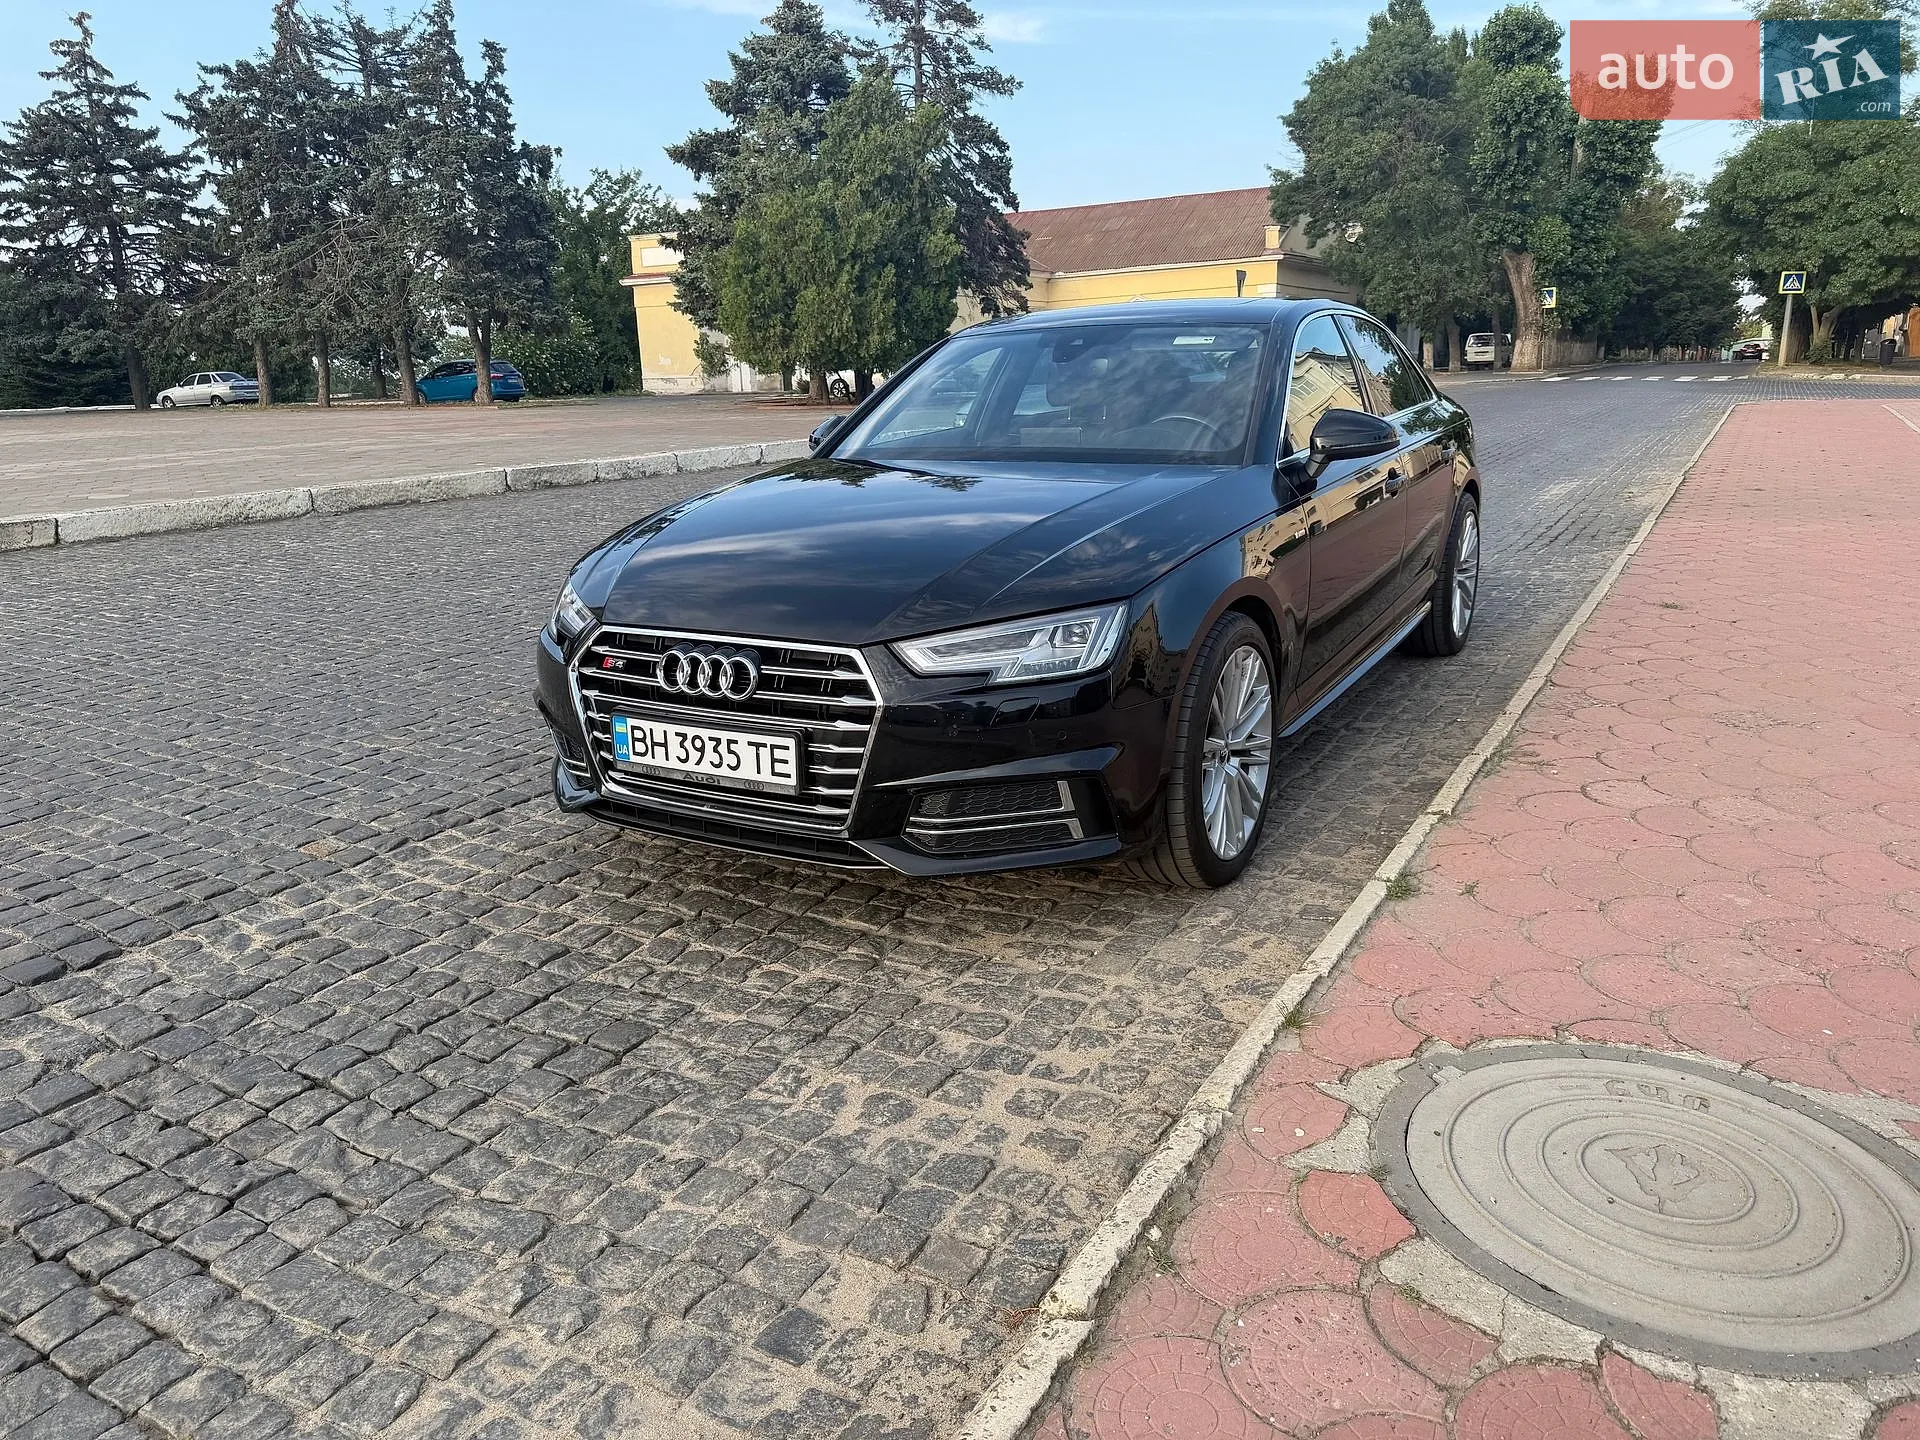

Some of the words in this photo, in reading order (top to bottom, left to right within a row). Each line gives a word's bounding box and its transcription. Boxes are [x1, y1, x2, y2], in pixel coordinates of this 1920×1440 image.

[617, 744, 628, 755] UA
[630, 724, 670, 761] BH
[675, 731, 742, 771] 3935
[747, 740, 792, 779] TE
[683, 772, 721, 785] Audi
